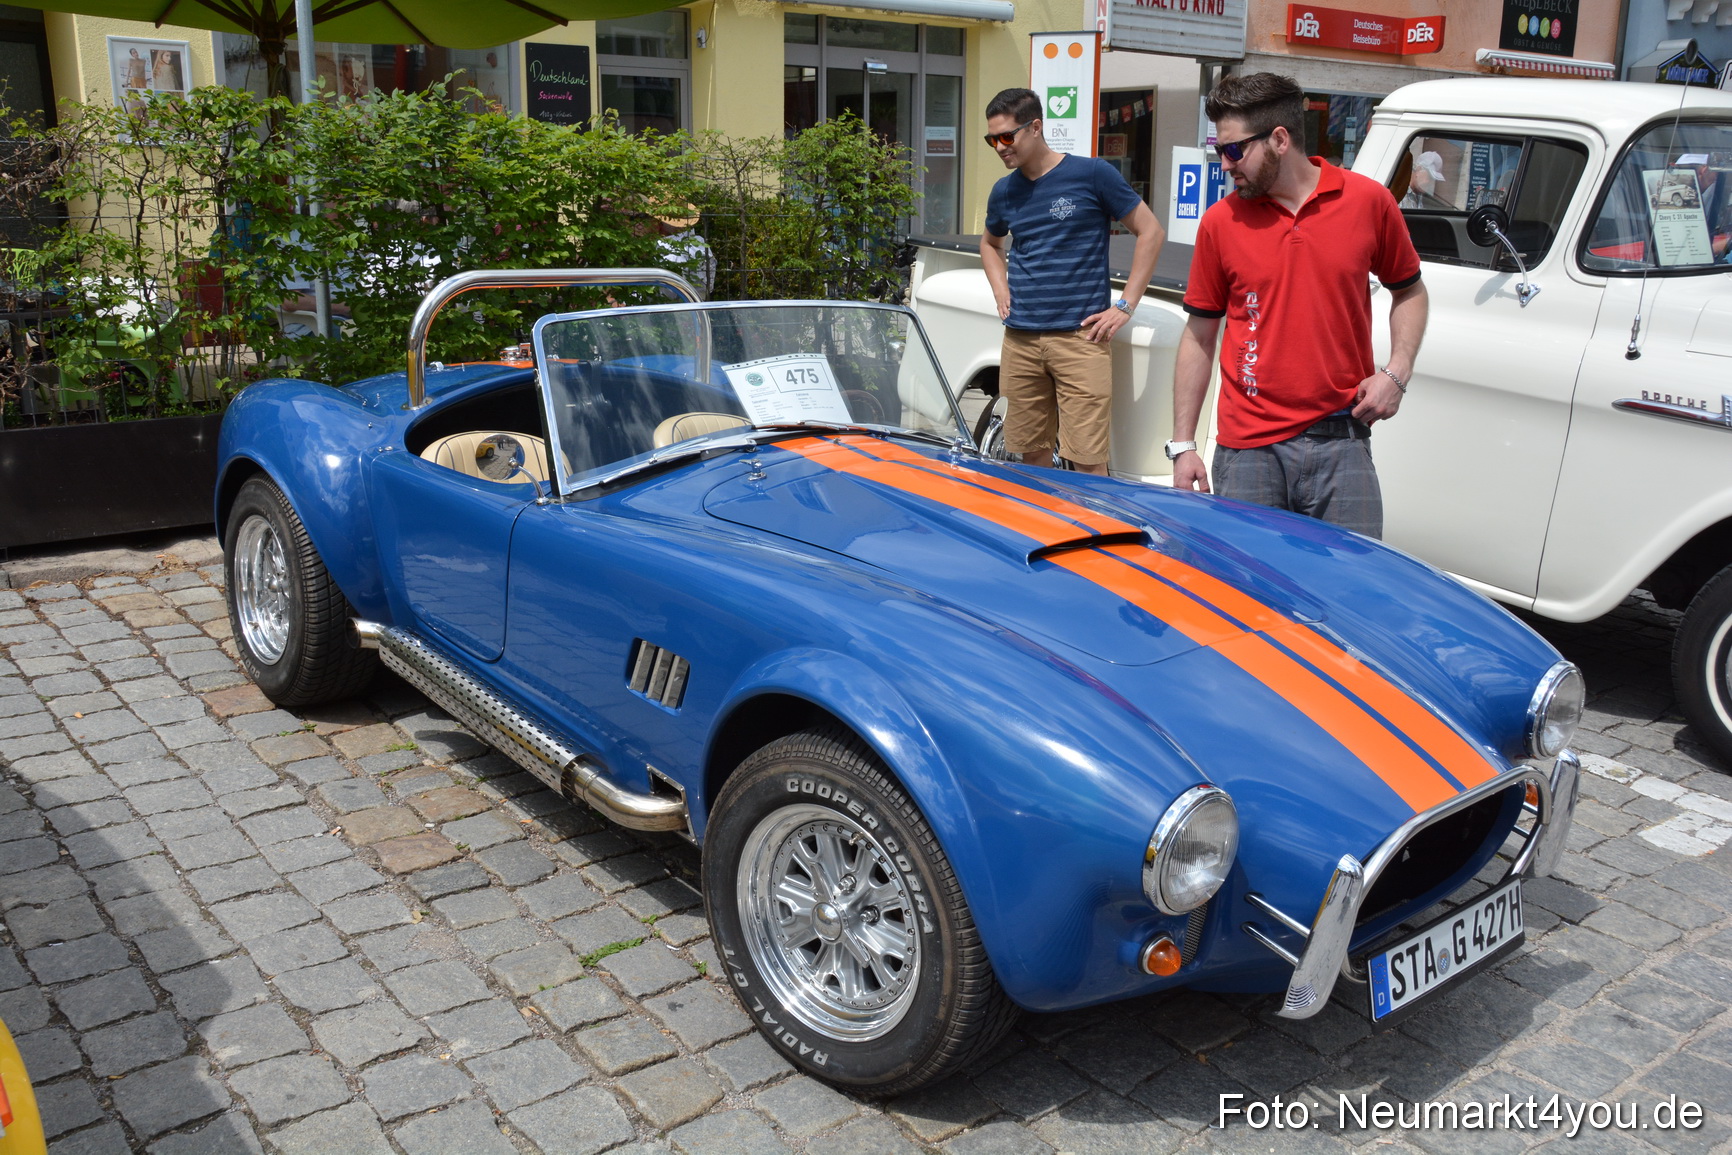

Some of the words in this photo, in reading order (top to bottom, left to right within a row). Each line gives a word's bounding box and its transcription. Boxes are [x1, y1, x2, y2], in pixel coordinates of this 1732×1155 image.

[1295, 17, 1320, 39] DER
[1353, 19, 1384, 31] Deutsches
[1407, 26, 1435, 43] DER
[1353, 33, 1381, 45] Reisebüro
[1513, 38, 1529, 48] OBST
[1536, 41, 1562, 51] GEMÜSE
[1051, 128, 1068, 137] BNI
[1182, 171, 1196, 196] P
[1178, 203, 1197, 216] SCHEINE
[785, 368, 819, 385] 475
[1242, 340, 1258, 397] POWER
[1642, 390, 1707, 411] APACHE
[786, 778, 880, 830] COOPER
[883, 836, 934, 934] COBRA
[1390, 936, 1438, 1001] STA
[1452, 918, 1467, 965] G
[1472, 885, 1522, 951] 427H
[1378, 991, 1385, 1006] D
[753, 996, 829, 1066] RADIAL
